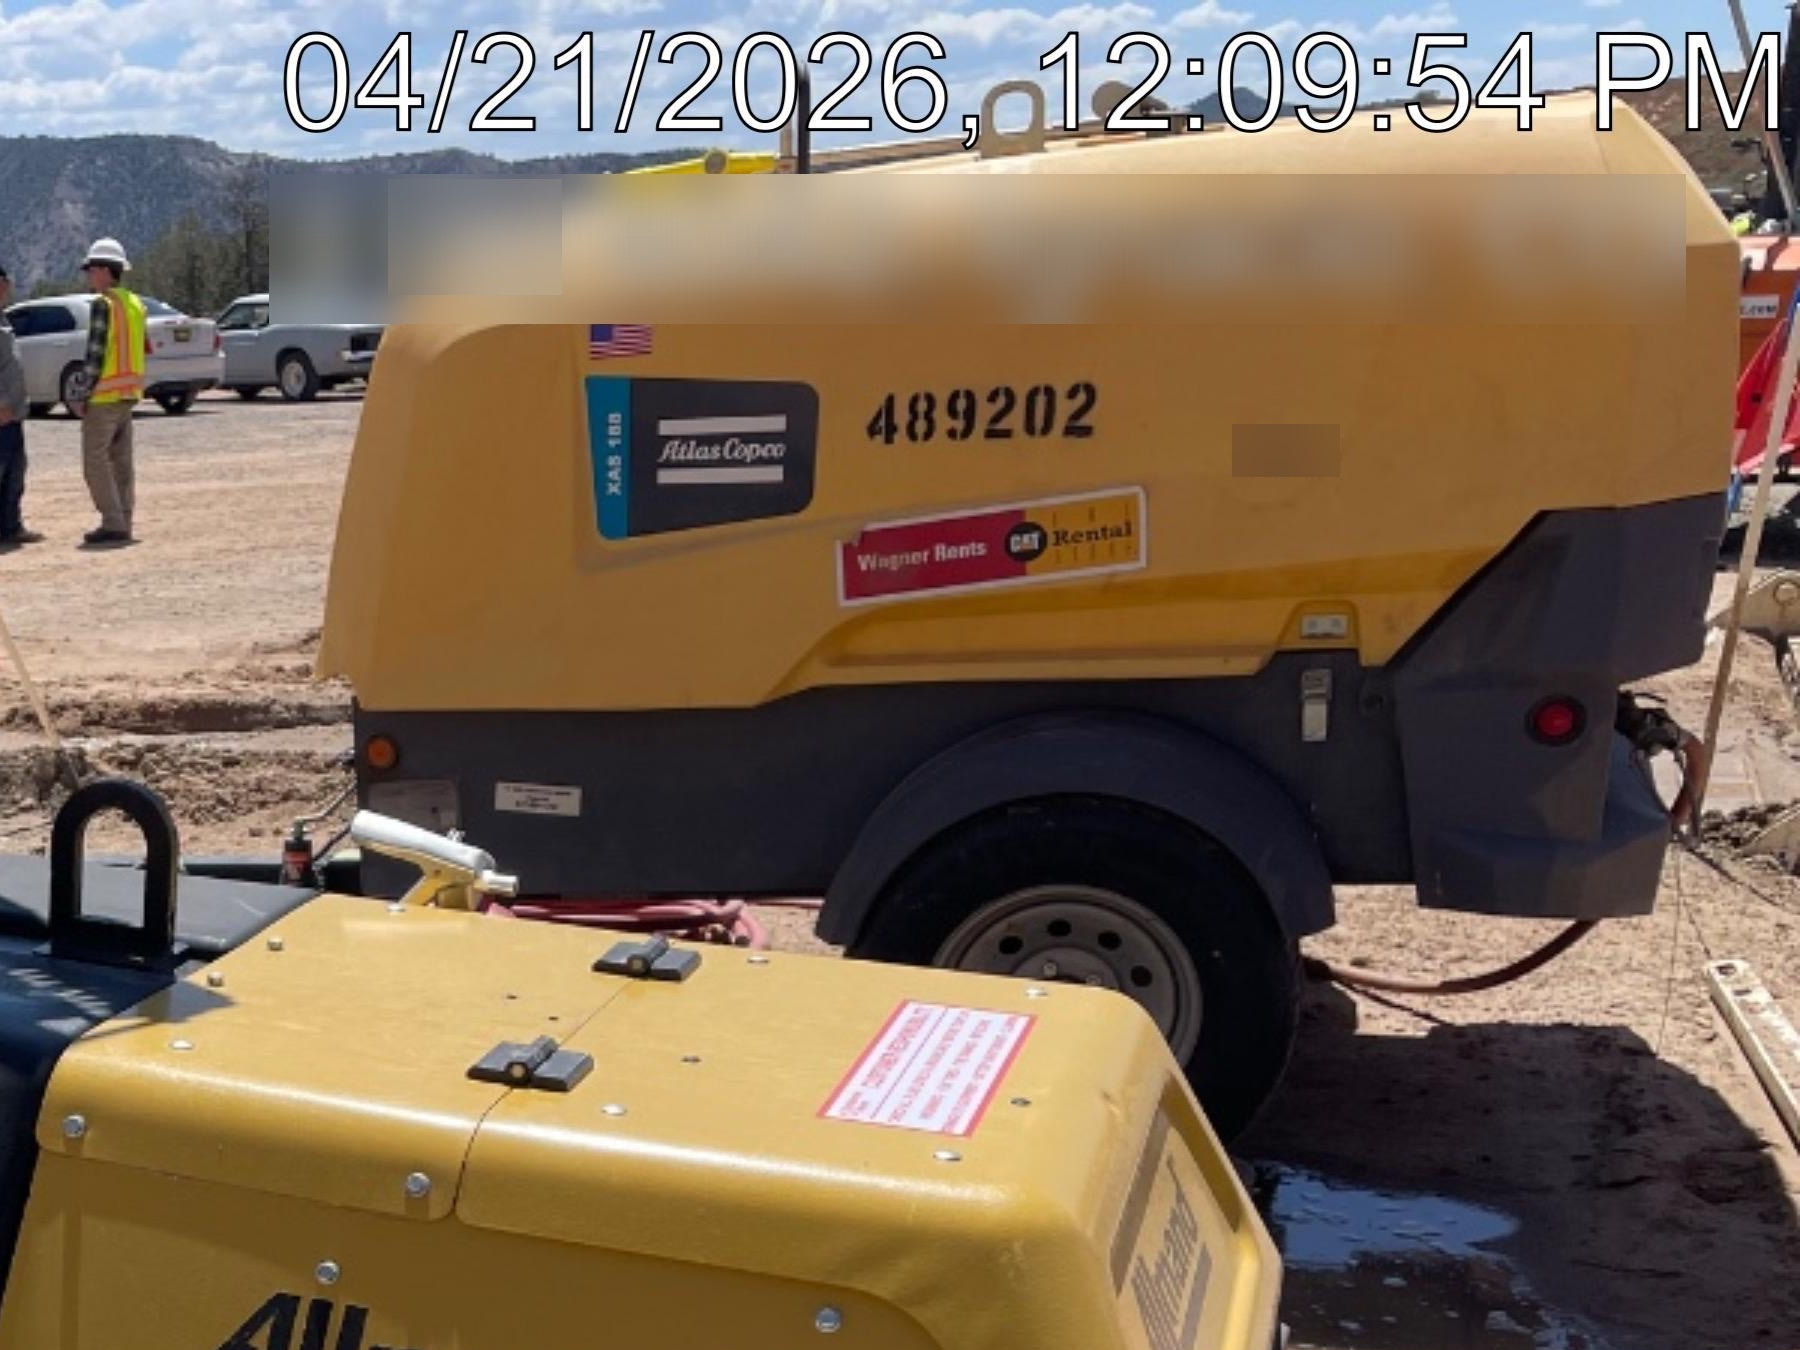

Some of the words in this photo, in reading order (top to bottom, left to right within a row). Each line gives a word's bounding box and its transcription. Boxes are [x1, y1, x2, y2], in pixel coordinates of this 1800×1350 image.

[865, 382, 1098, 446] 489202
[657, 438, 721, 463] Atlas
[722, 437, 787, 463] Copco
[607, 455, 622, 496] XAS
[856, 549, 930, 572] Wagner
[934, 540, 988, 562] Rents
[1009, 531, 1040, 553] CAT
[1051, 519, 1133, 547] Rental
